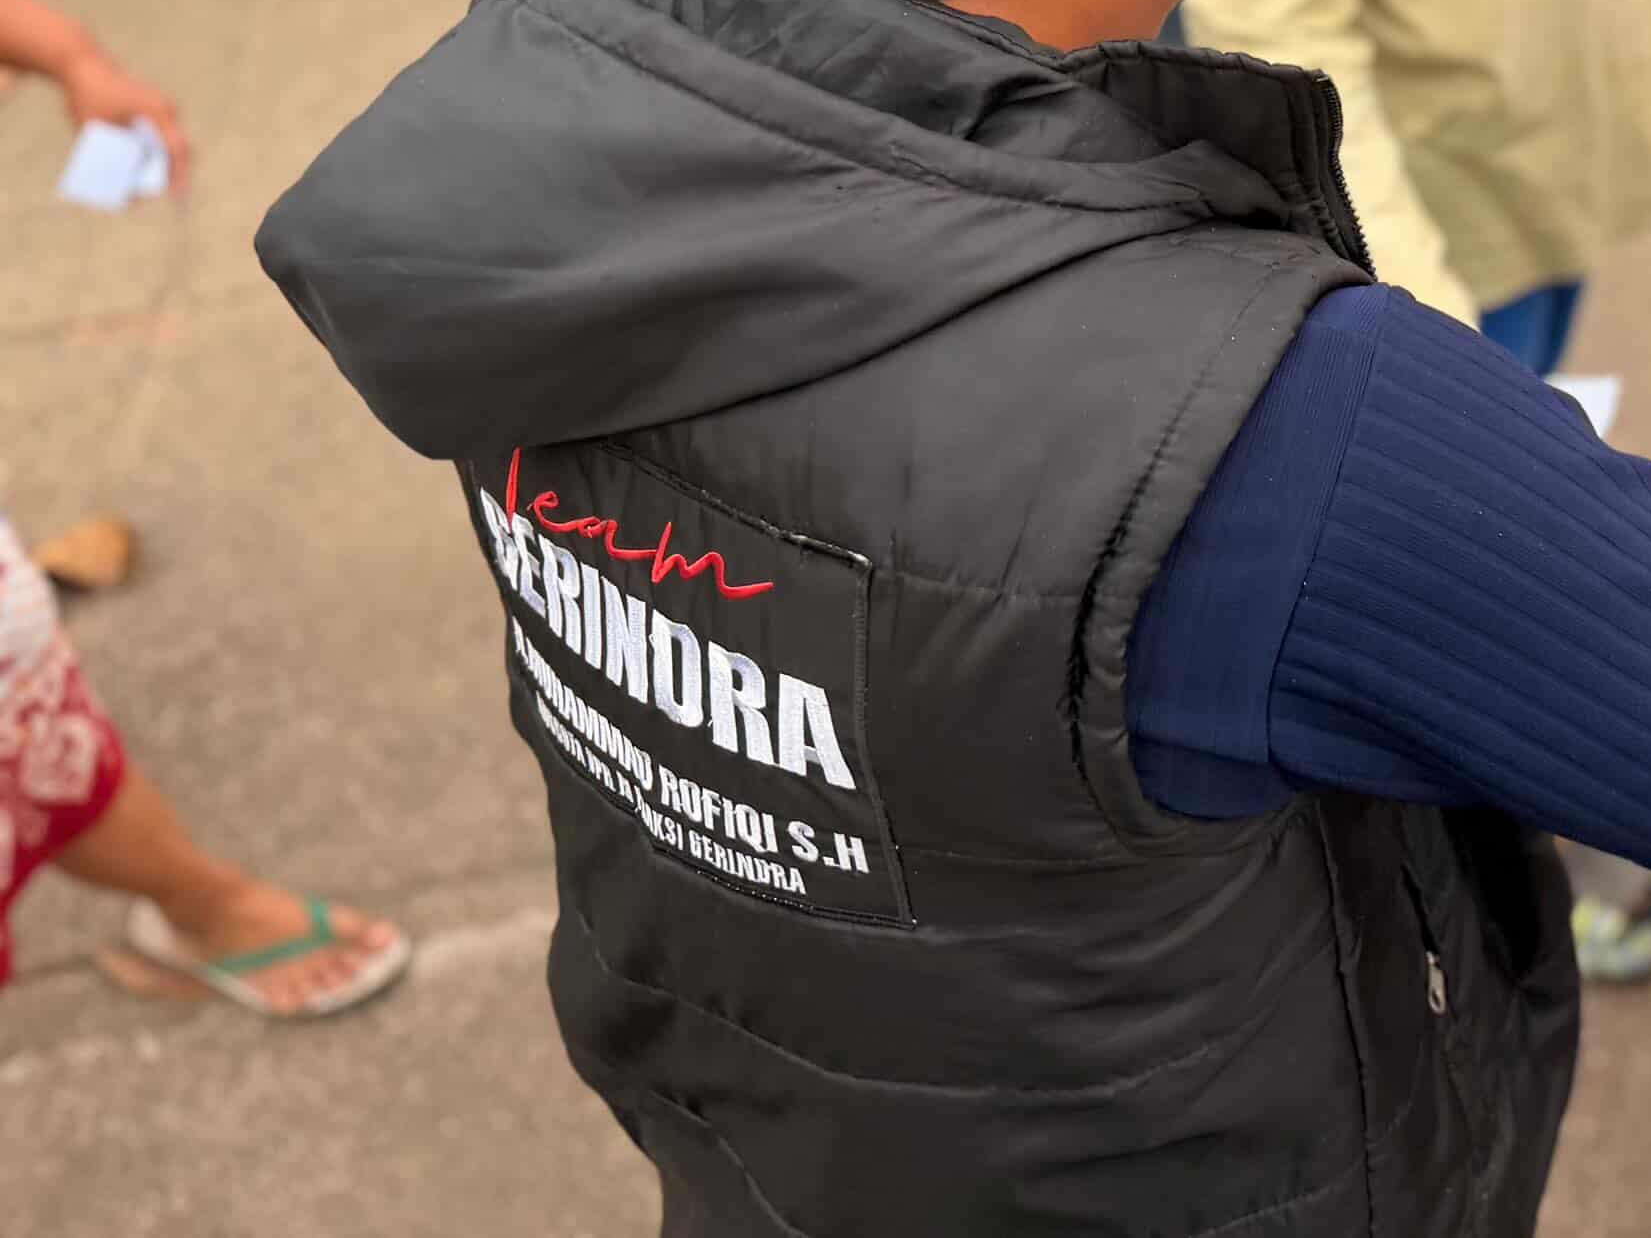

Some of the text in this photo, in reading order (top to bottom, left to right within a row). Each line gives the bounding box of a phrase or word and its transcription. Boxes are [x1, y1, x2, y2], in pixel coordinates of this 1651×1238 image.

[480, 490, 856, 790] GERINDRA
[661, 767, 779, 852] ROFIQI
[788, 822, 870, 873] S.H
[690, 832, 807, 893] GERINDRA
